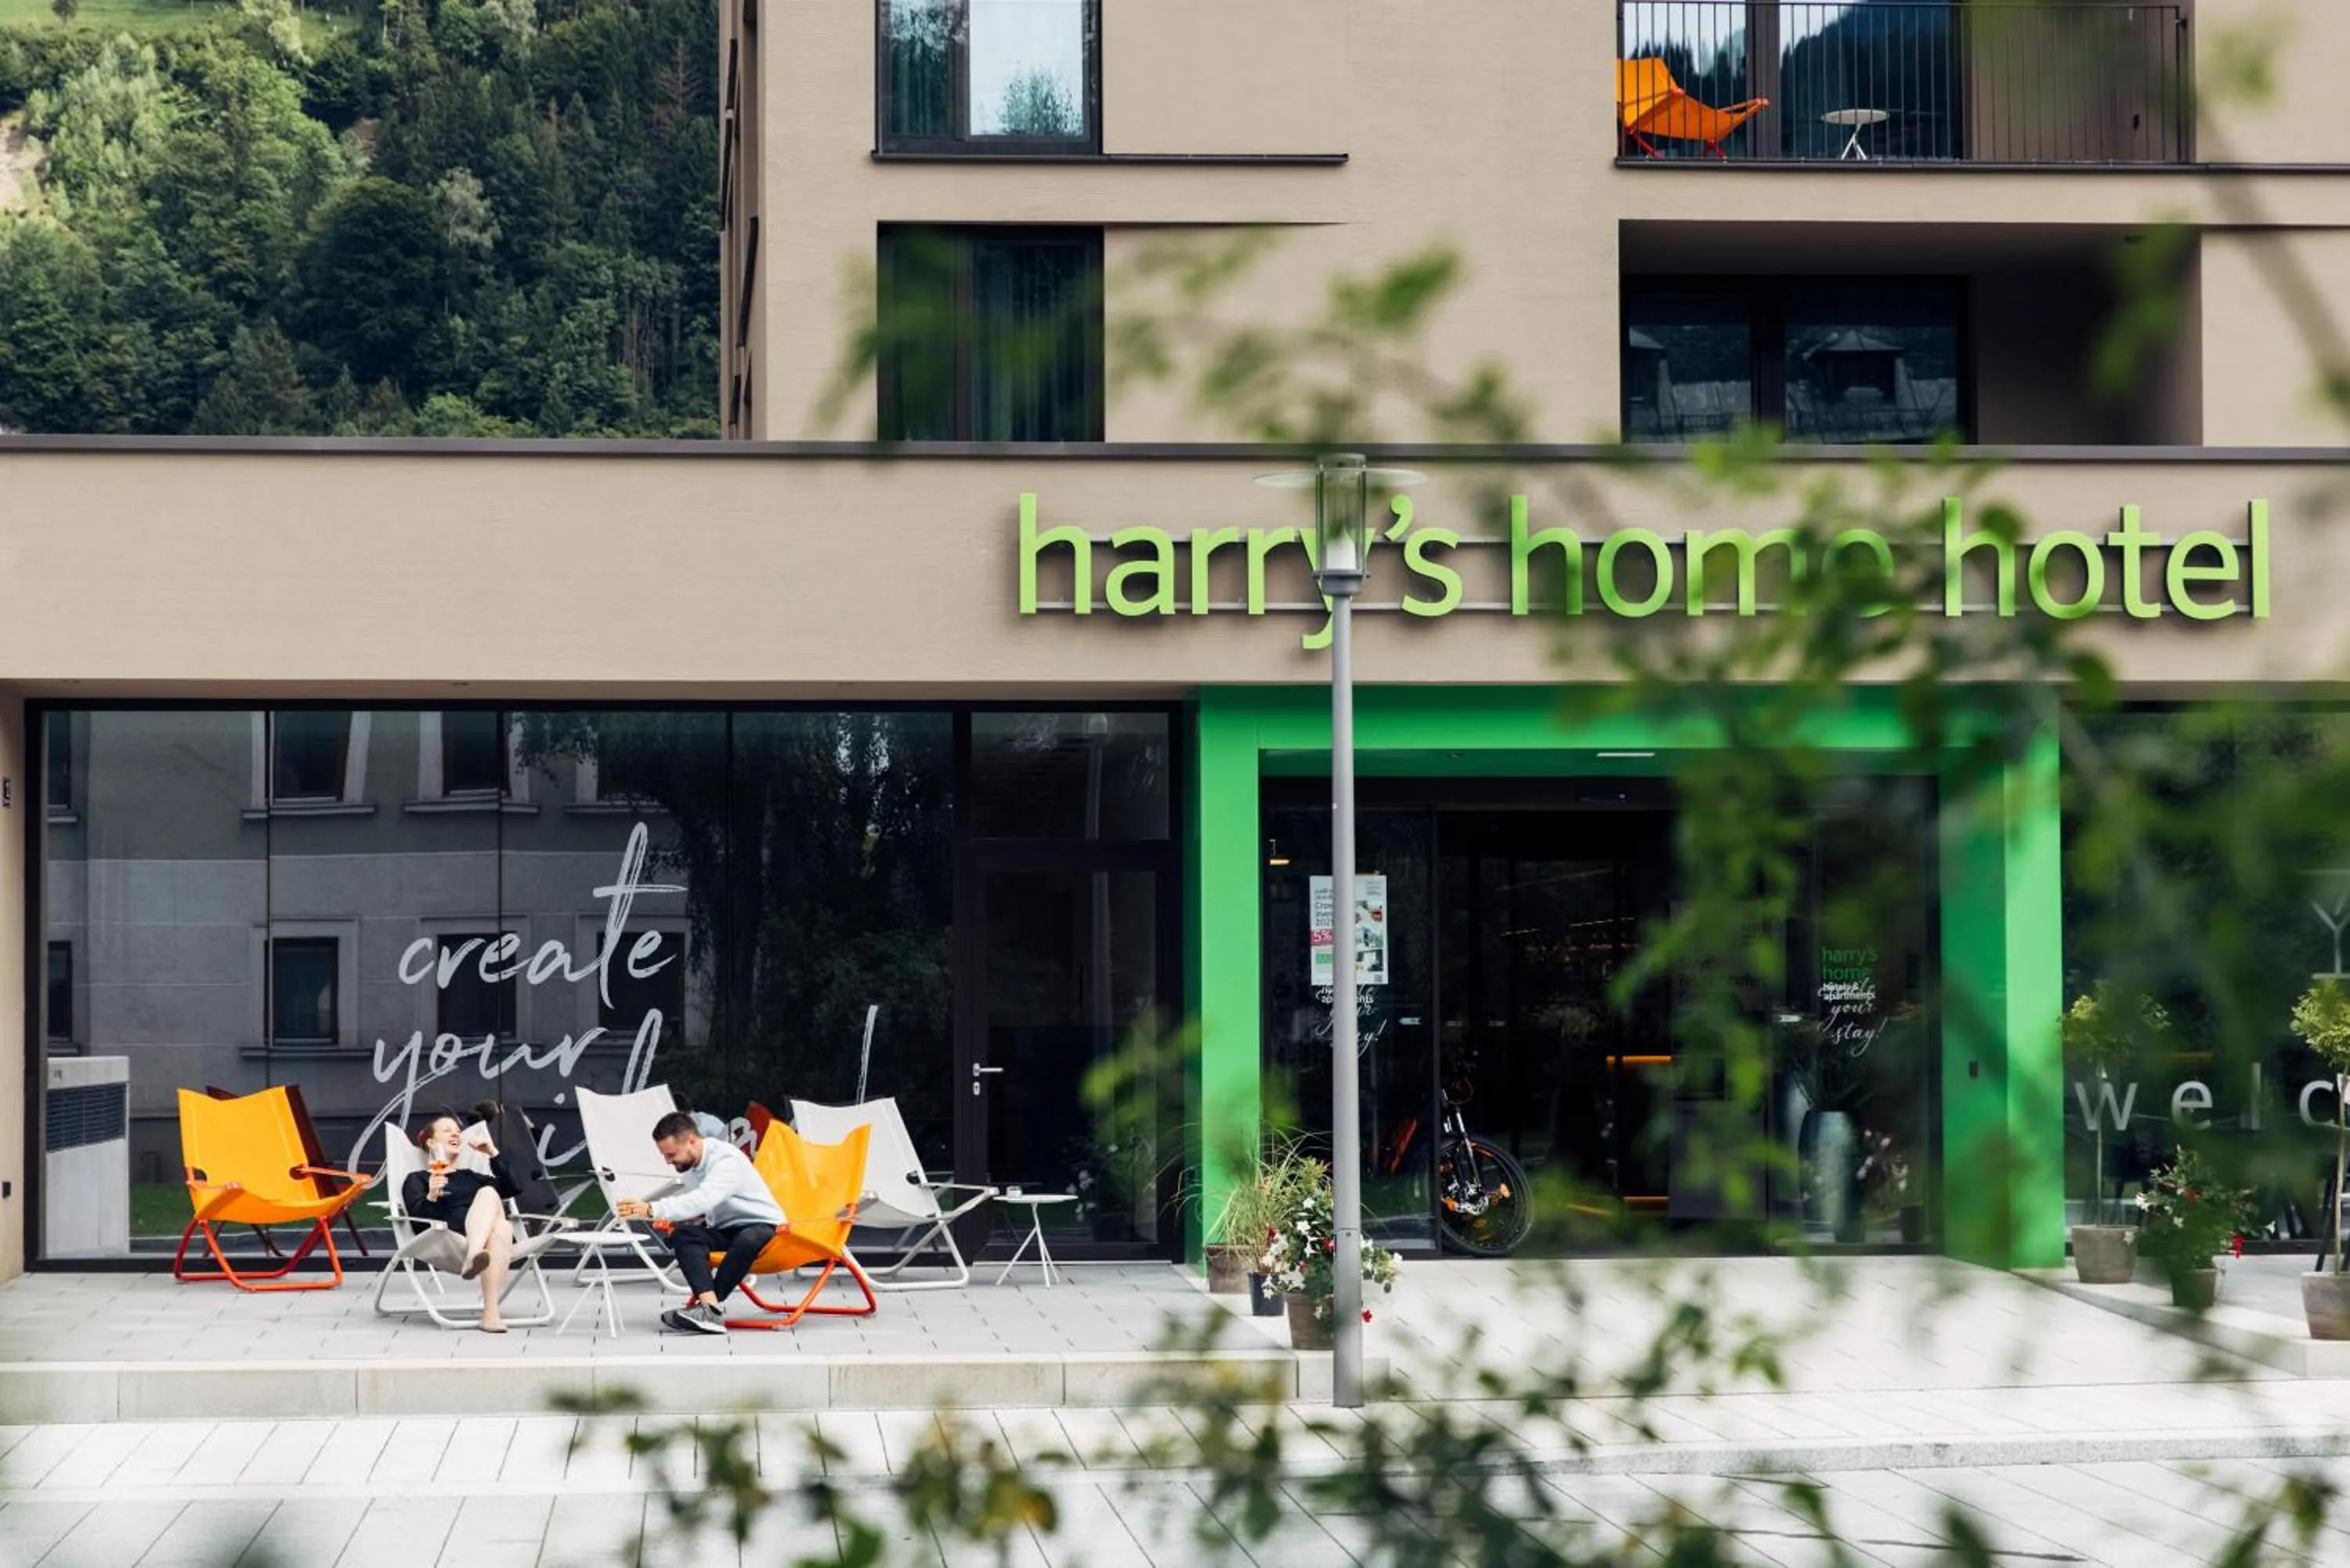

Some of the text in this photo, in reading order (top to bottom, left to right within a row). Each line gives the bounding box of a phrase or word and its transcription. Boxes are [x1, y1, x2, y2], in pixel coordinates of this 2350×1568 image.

[1943, 497, 2269, 620] hotel
[398, 821, 688, 1009] create
[1823, 964, 1872, 980] home
[348, 1027, 610, 1188] your
